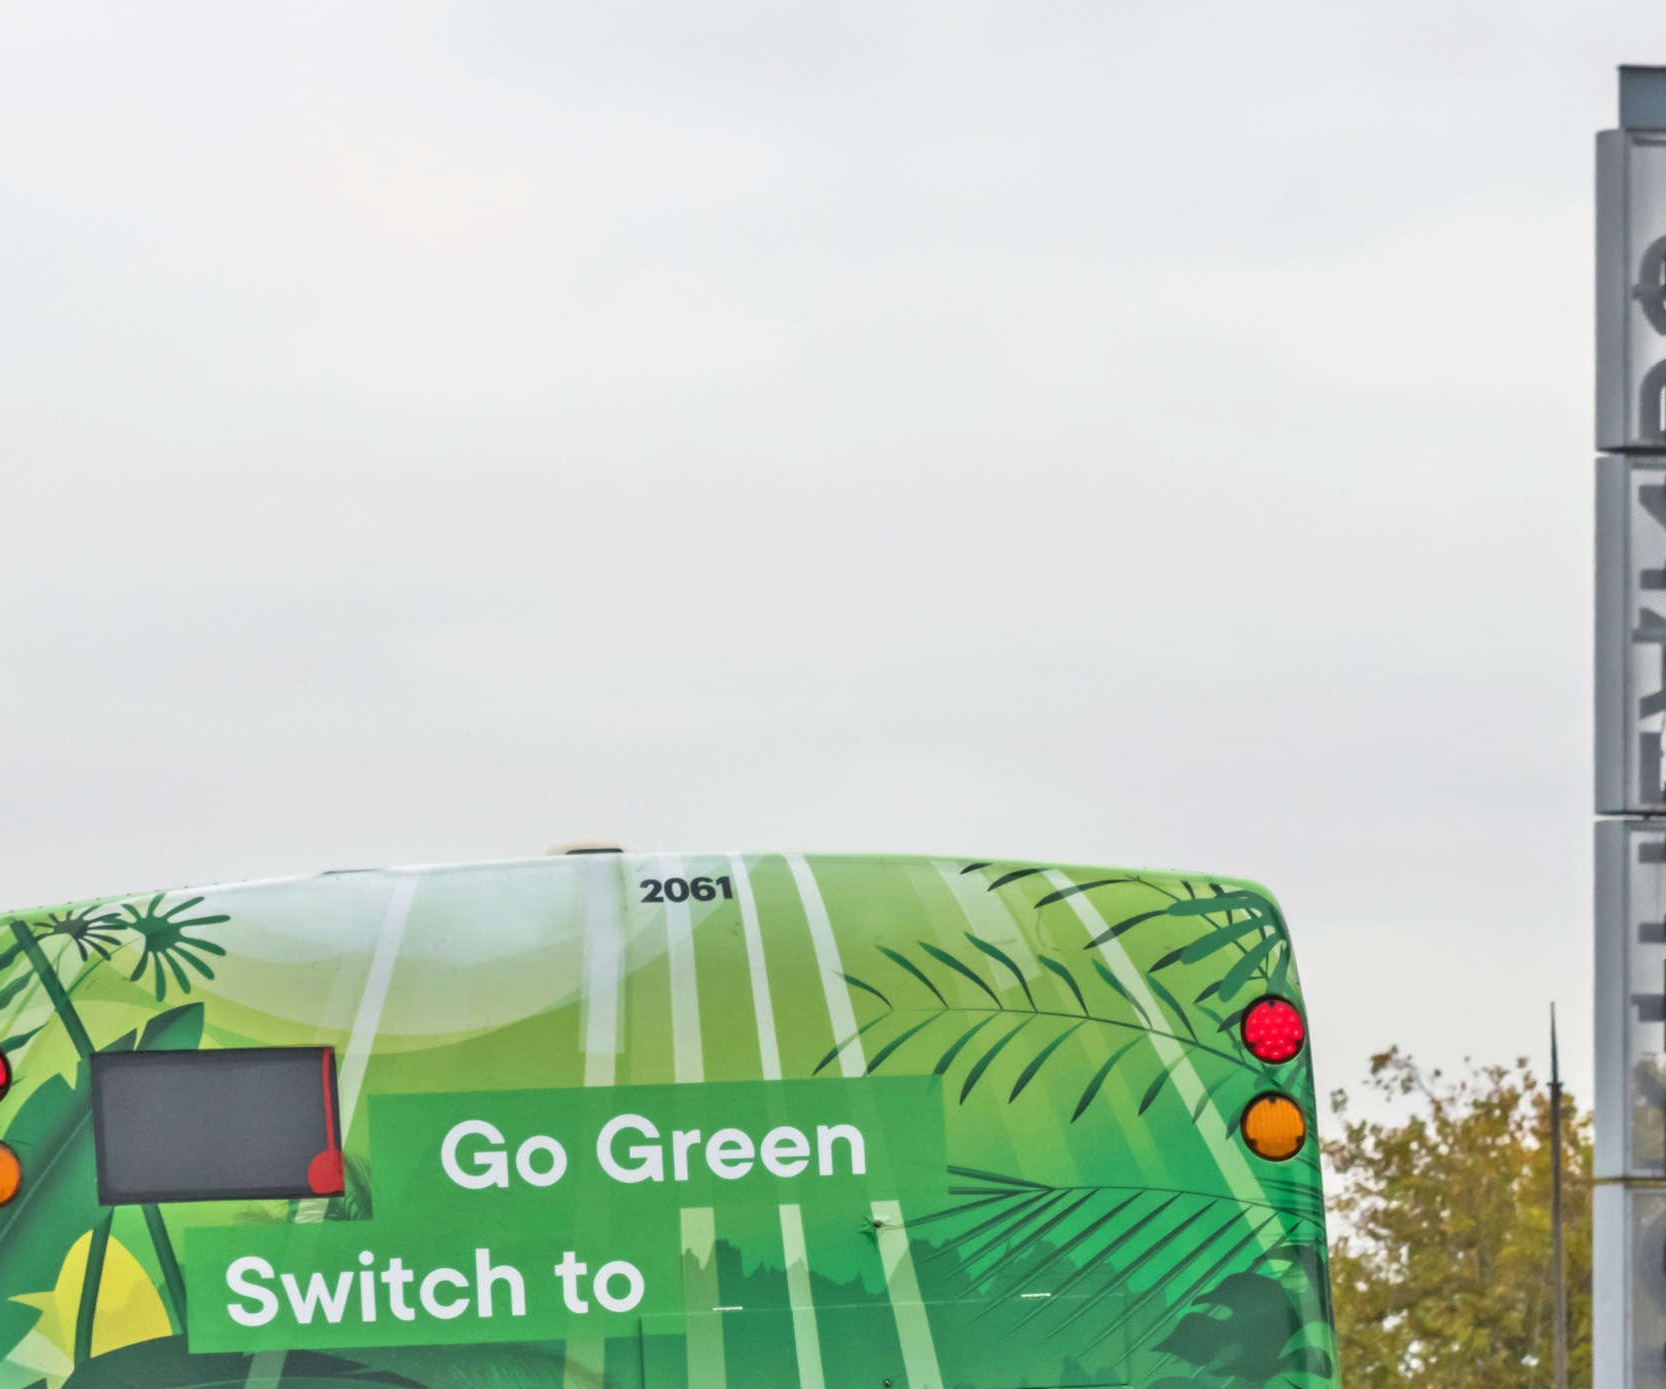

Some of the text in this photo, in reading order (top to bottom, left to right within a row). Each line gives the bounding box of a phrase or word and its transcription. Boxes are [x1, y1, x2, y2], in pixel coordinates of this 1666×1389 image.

[639, 876, 733, 904] 2061
[441, 1113, 867, 1190] Go Green
[225, 1248, 646, 1328] Switch to
